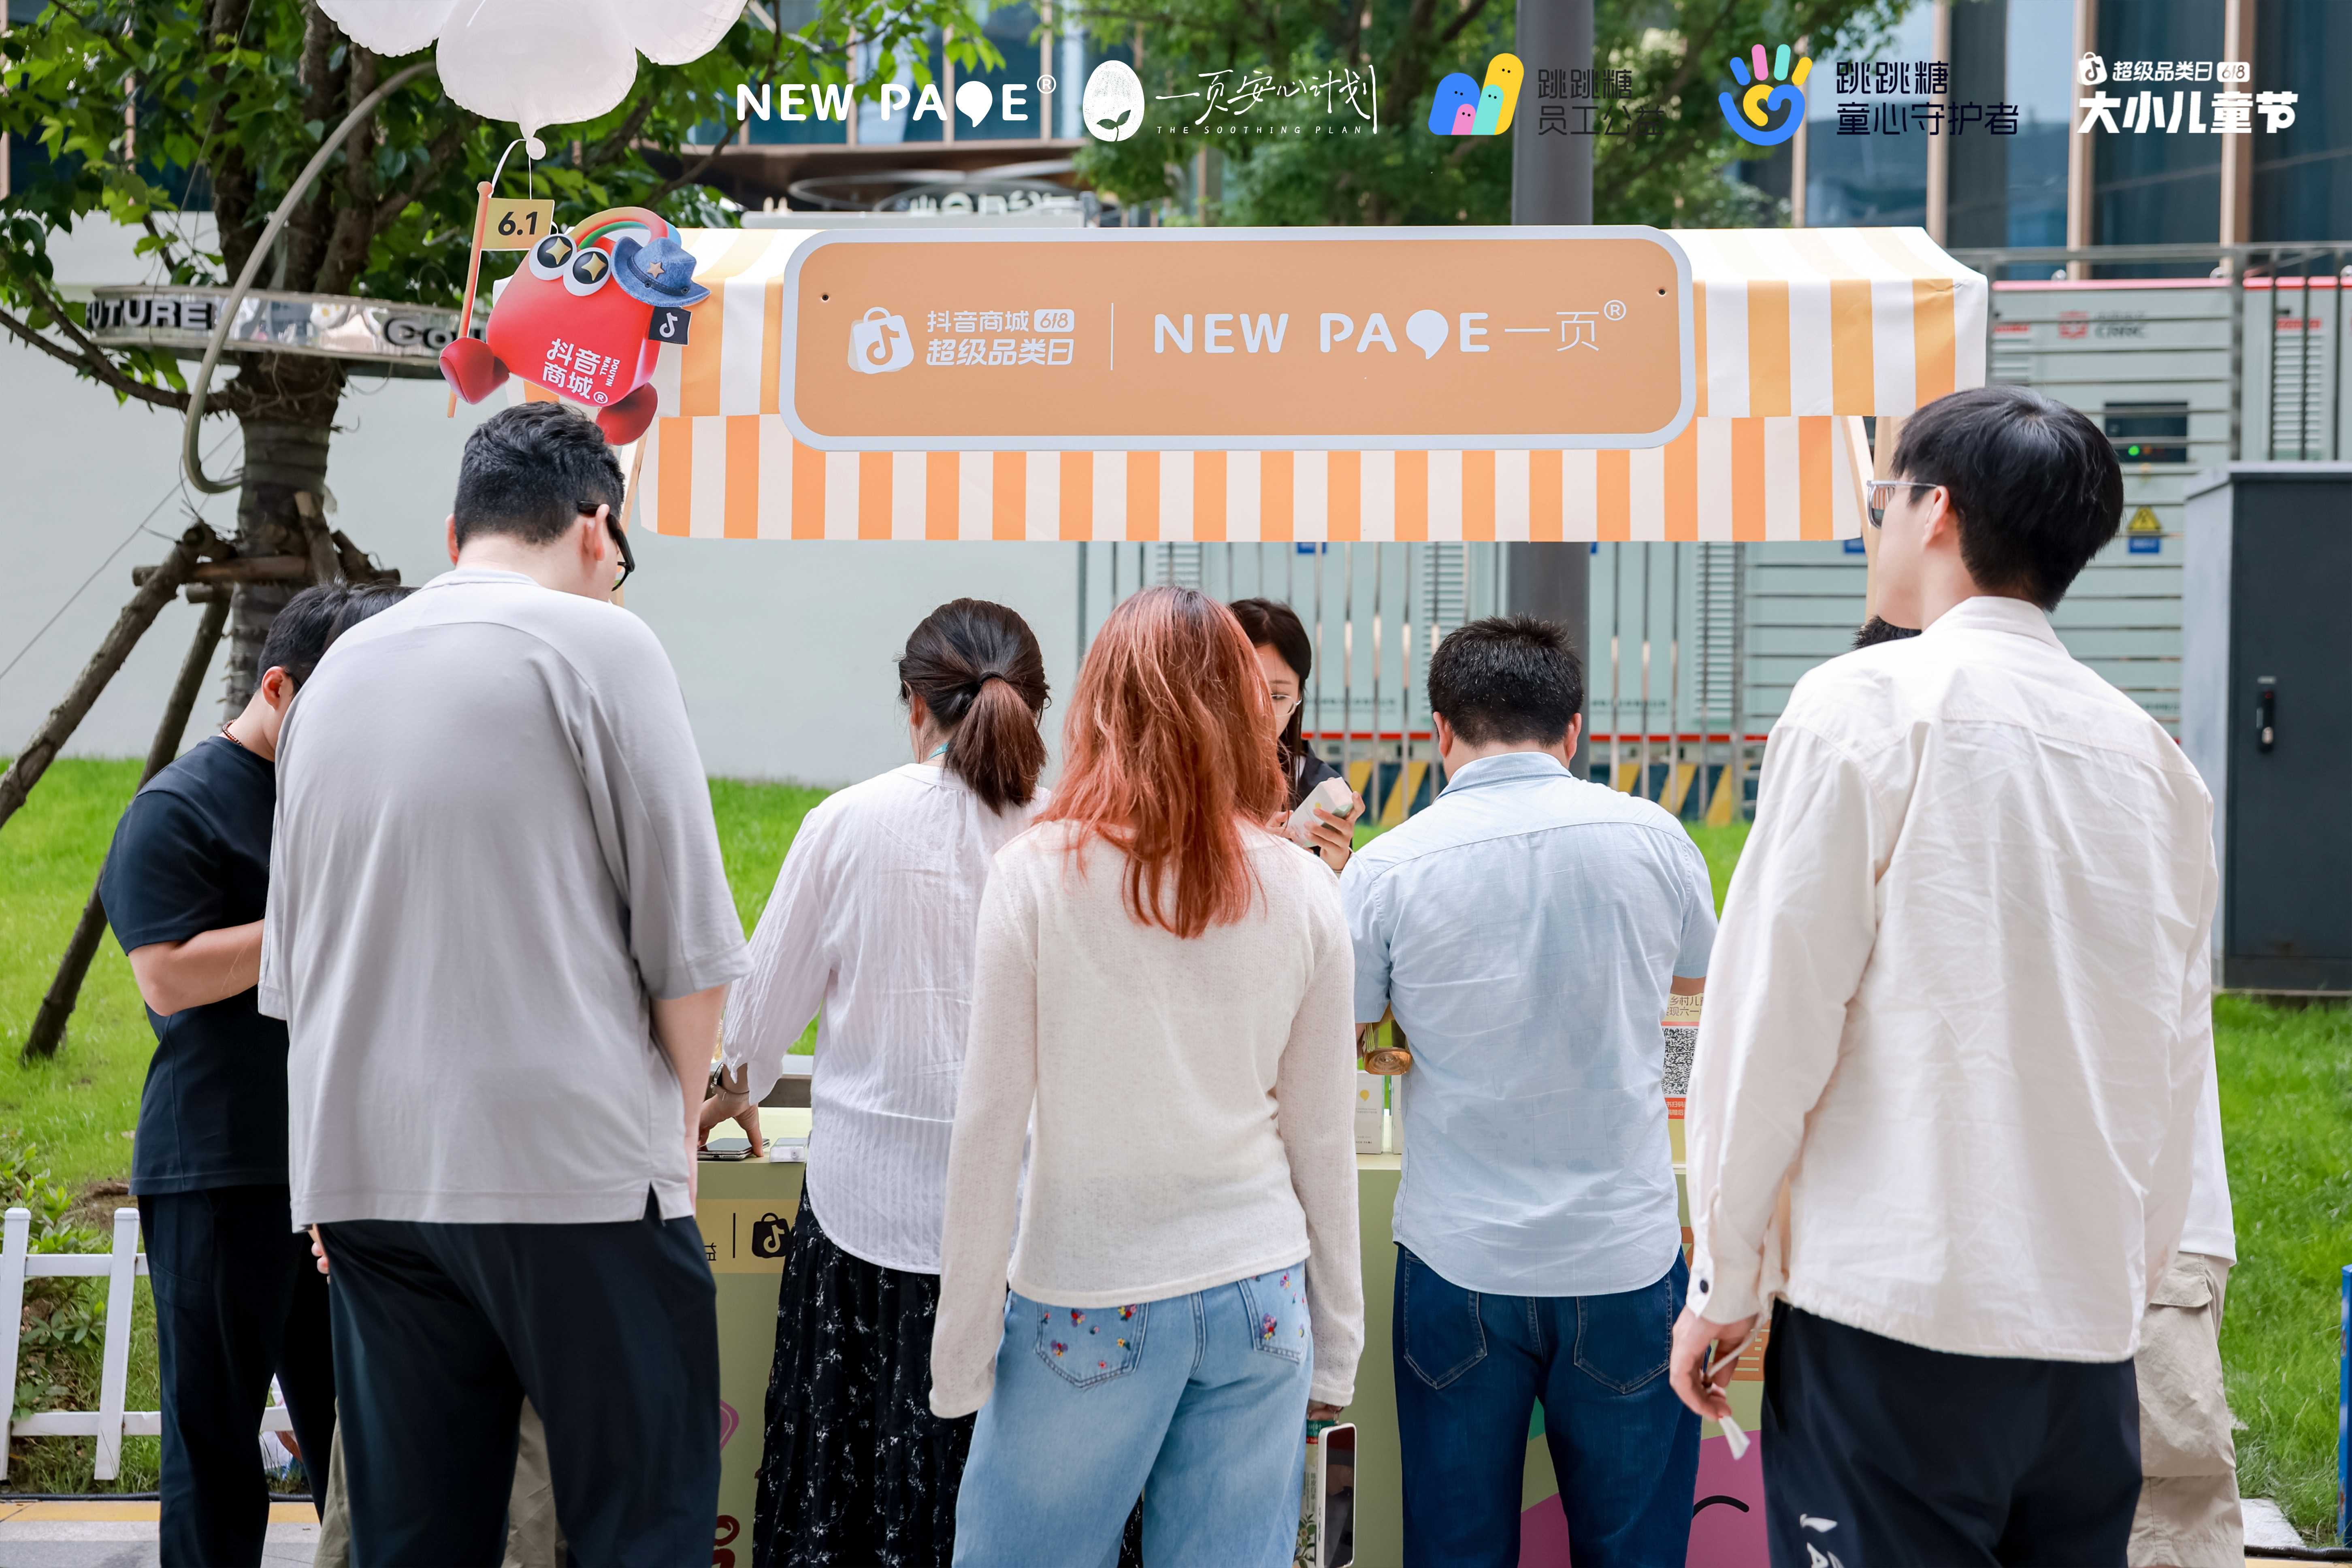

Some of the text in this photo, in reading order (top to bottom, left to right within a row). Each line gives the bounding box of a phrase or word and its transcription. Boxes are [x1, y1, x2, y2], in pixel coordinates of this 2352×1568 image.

[498, 211, 538, 236] 6.1
[927, 310, 1070, 332] 抖音商城 618
[1155, 313, 1289, 354] NEW
[546, 338, 601, 376] 抖音
[926, 338, 1074, 365] 超级品类日
[599, 356, 611, 376] MALL
[605, 359, 620, 387] DOUYIN
[542, 361, 593, 400] 商城
[1666, 1006, 1702, 1016] 现六一
